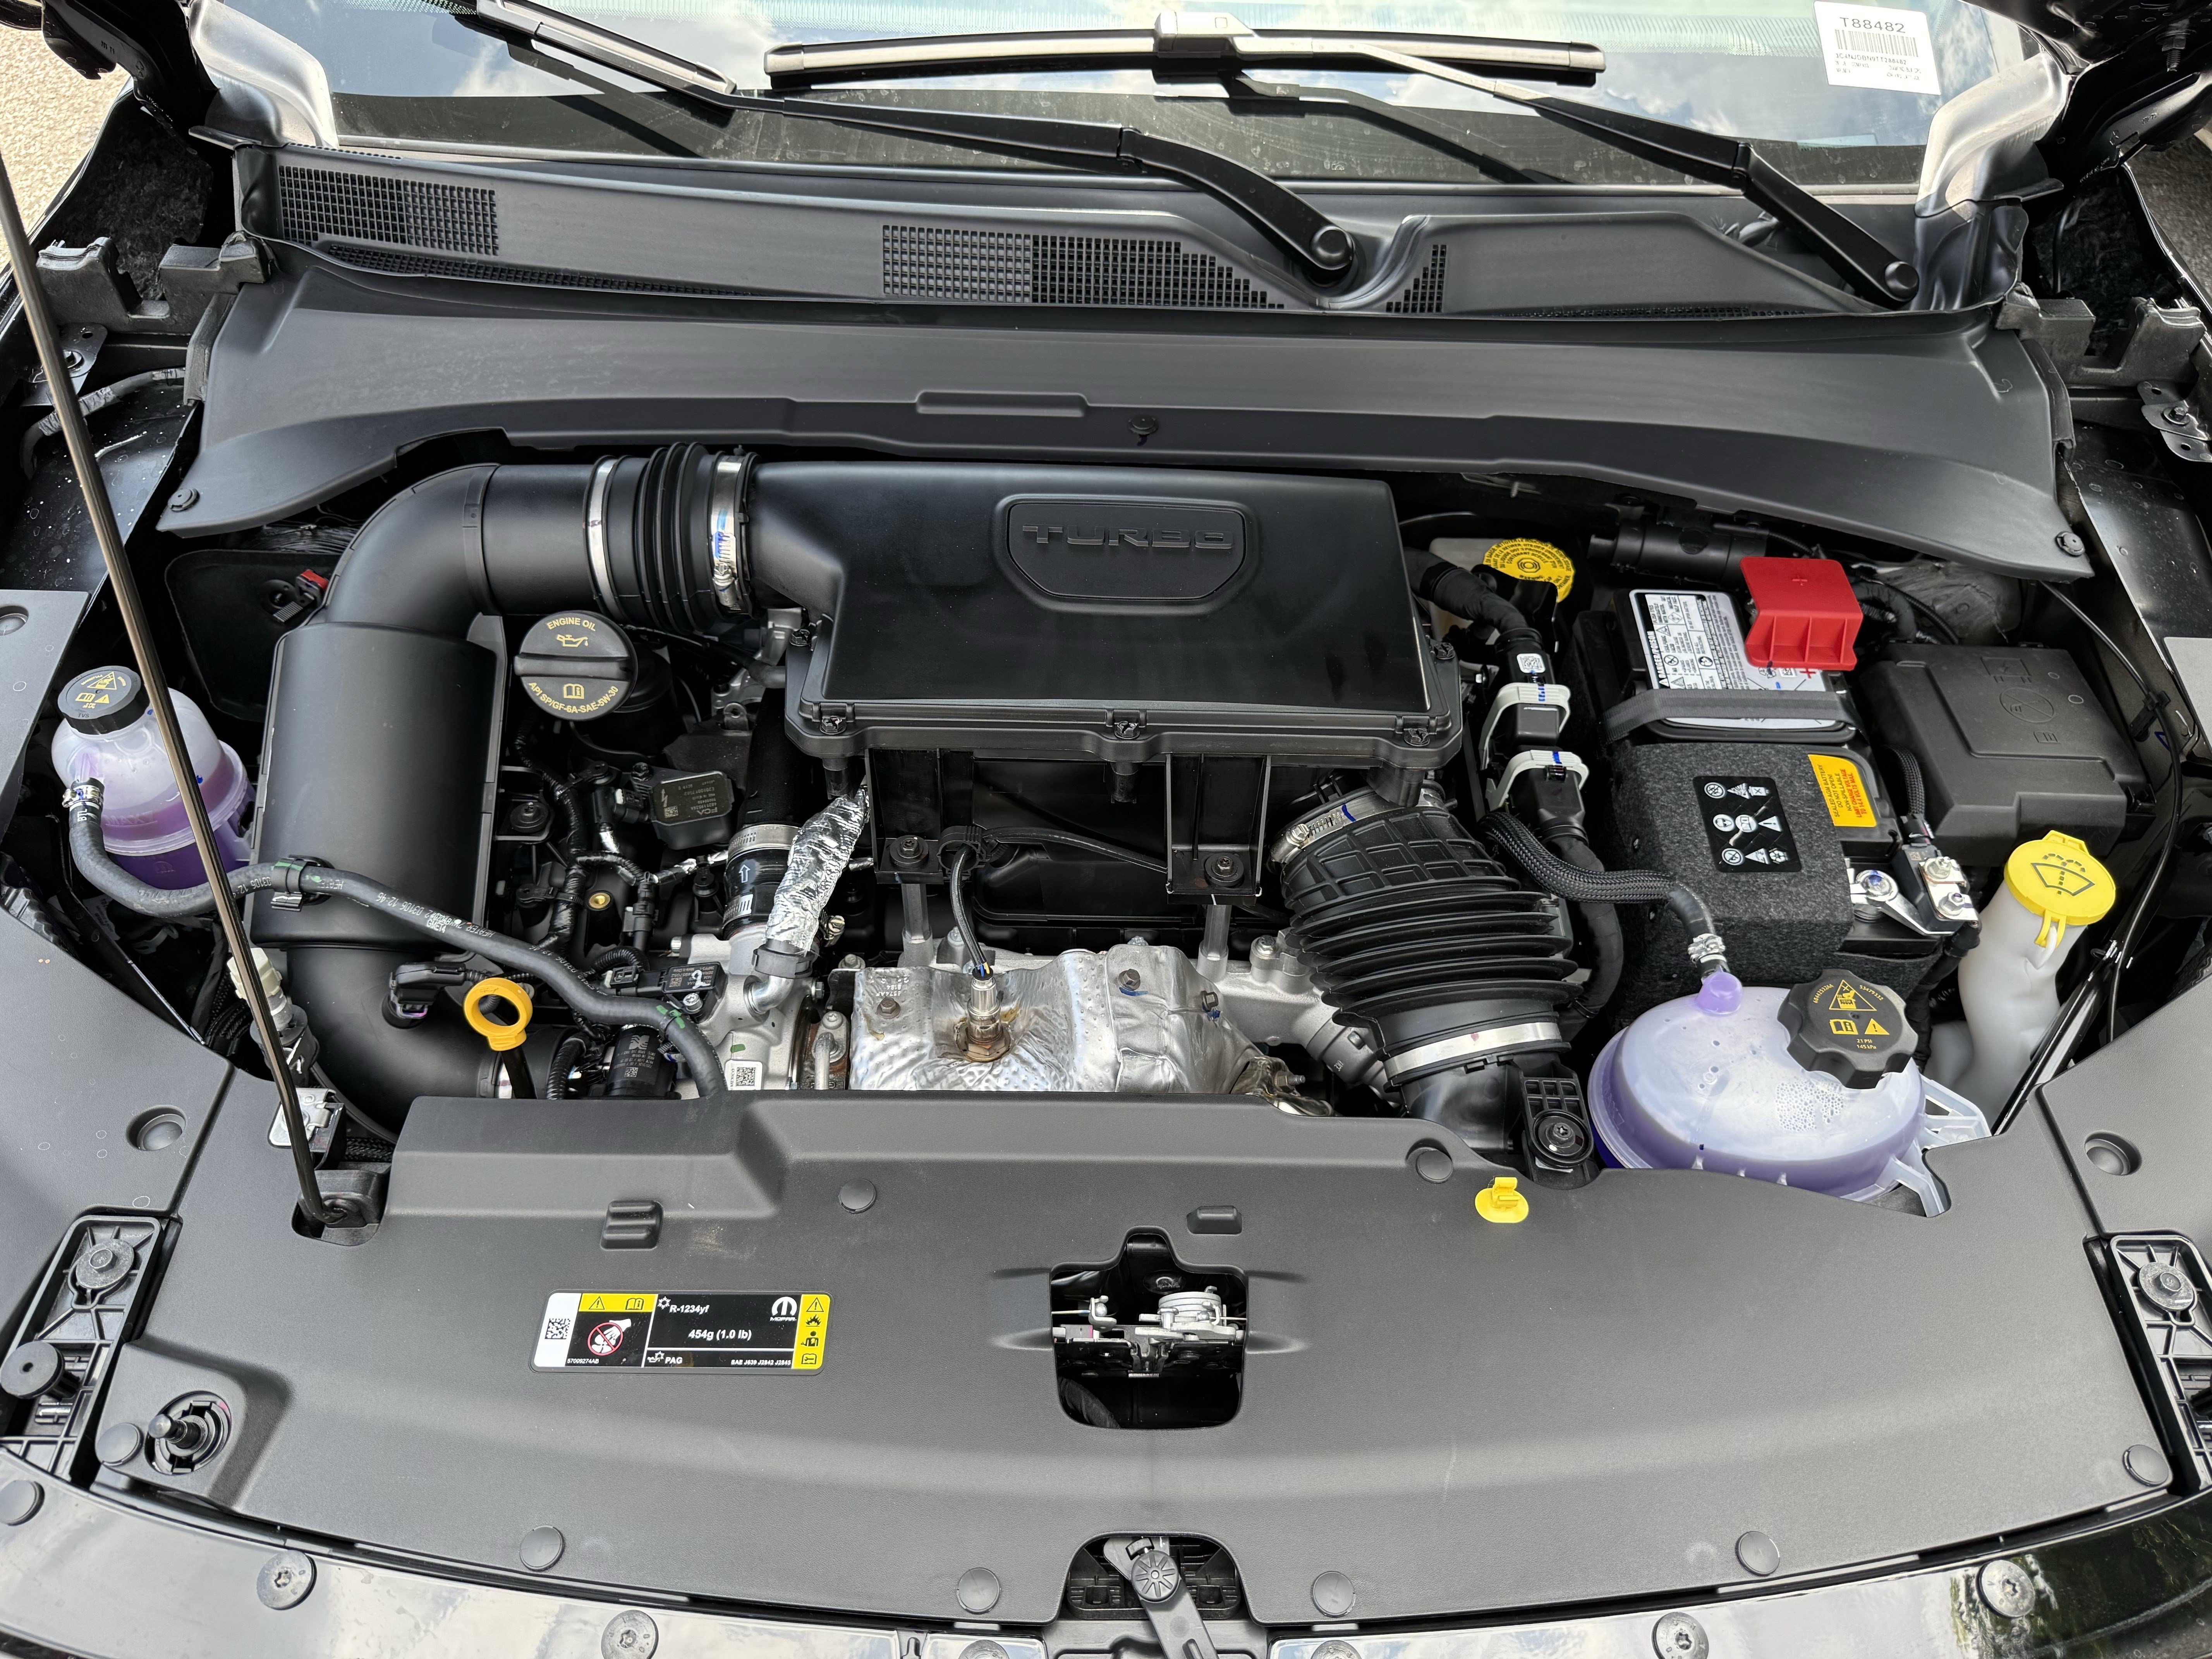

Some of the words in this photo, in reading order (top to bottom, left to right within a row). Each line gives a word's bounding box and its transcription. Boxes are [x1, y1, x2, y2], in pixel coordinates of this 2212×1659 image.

[1839, 17, 1905, 33] T88482
[1022, 524, 1234, 549] TURBO
[546, 617, 581, 630] ENGINE
[582, 620, 596, 631] OIL
[1647, 630, 1666, 678] DANGER/POISON
[529, 682, 542, 696] API
[1817, 764, 1829, 786] BATTERY
[1825, 787, 1833, 798] AGM
[1834, 773, 1852, 811] NON-SPILLABLE
[697, 807, 718, 815] FCA
[1829, 799, 1839, 817] SEALED
[400, 901, 424, 916] 03106
[466, 924, 497, 937] HEATER
[669, 1304, 710, 1315] R-1234yf
[688, 1329, 714, 1341] 454g
[716, 1329, 736, 1341] (1.0
[737, 1329, 752, 1341] lb)
